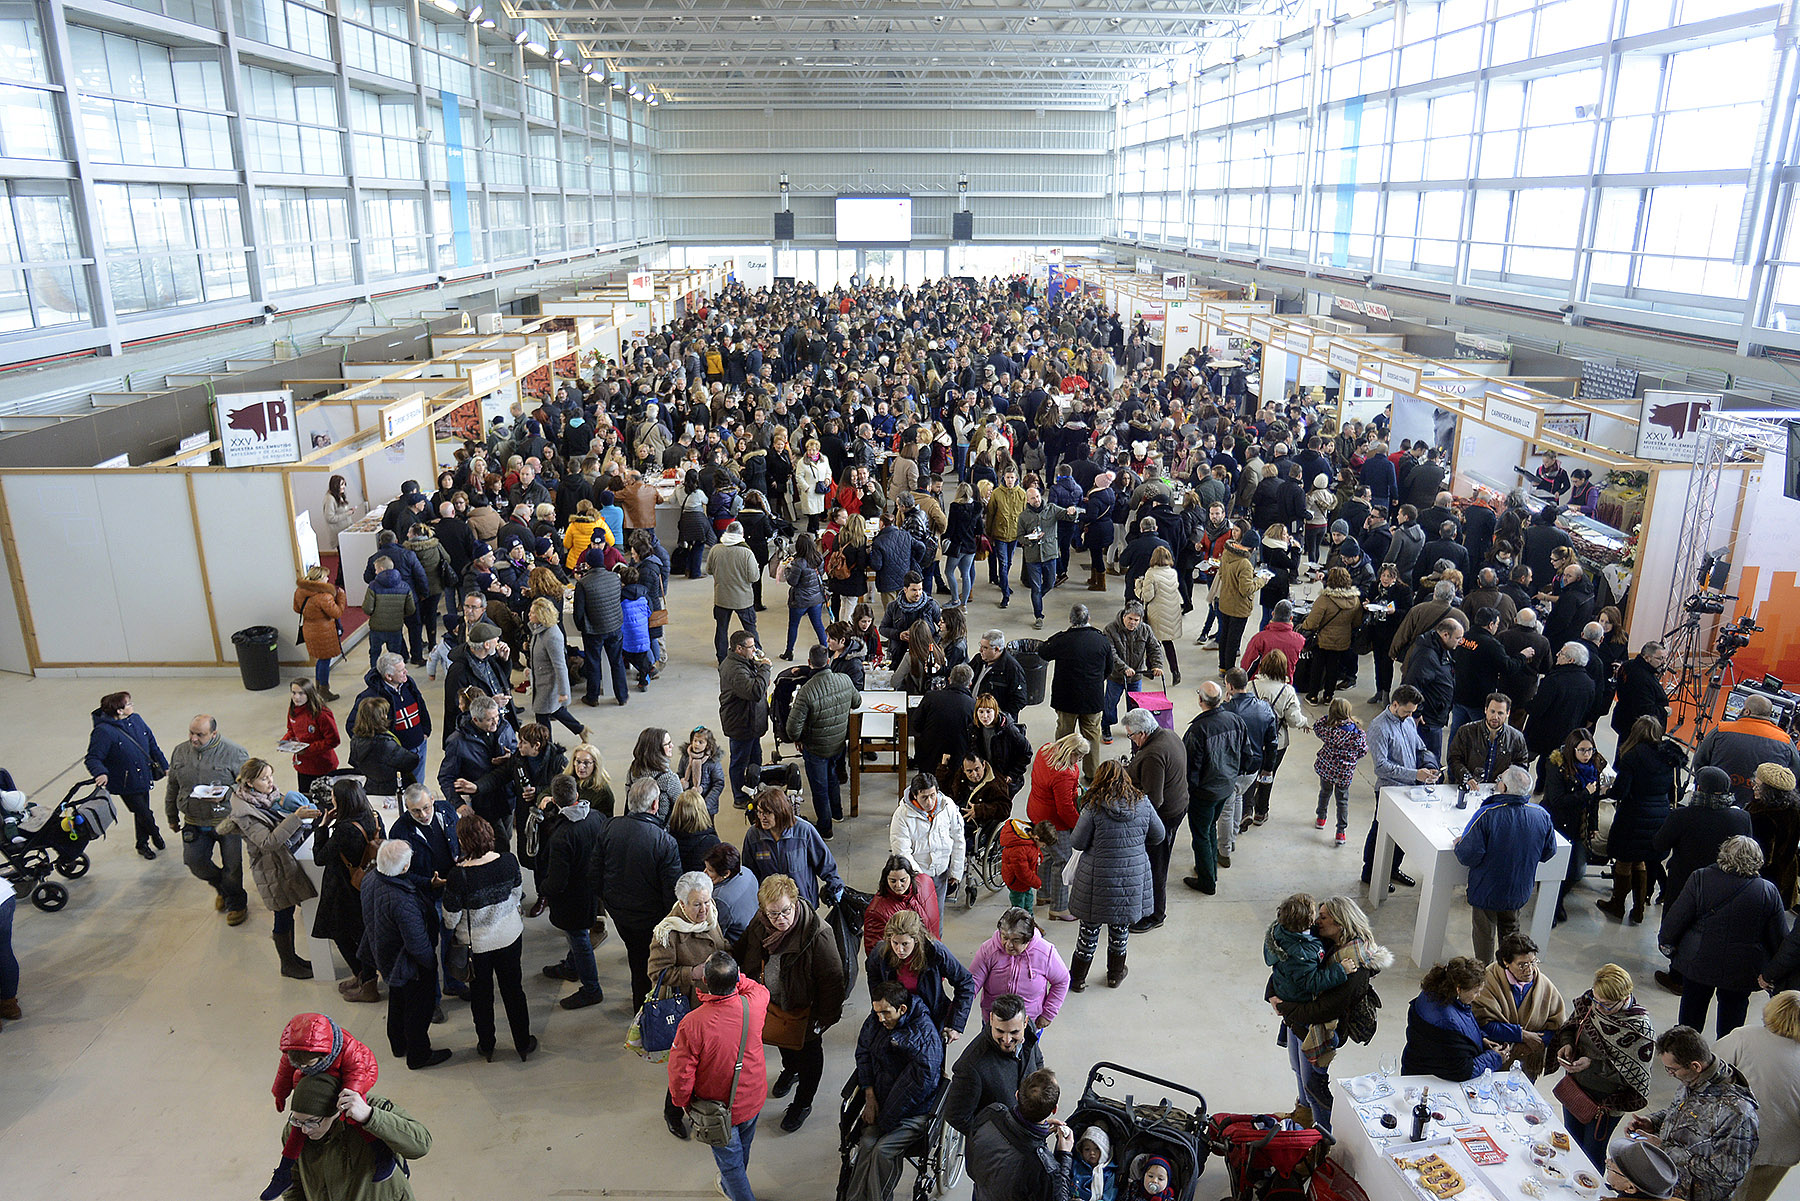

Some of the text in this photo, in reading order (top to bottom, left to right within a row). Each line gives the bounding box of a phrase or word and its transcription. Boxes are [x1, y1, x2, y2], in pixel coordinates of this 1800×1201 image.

[266, 400, 289, 432] R
[1646, 432, 1667, 440] XXV
[230, 437, 252, 447] XXV
